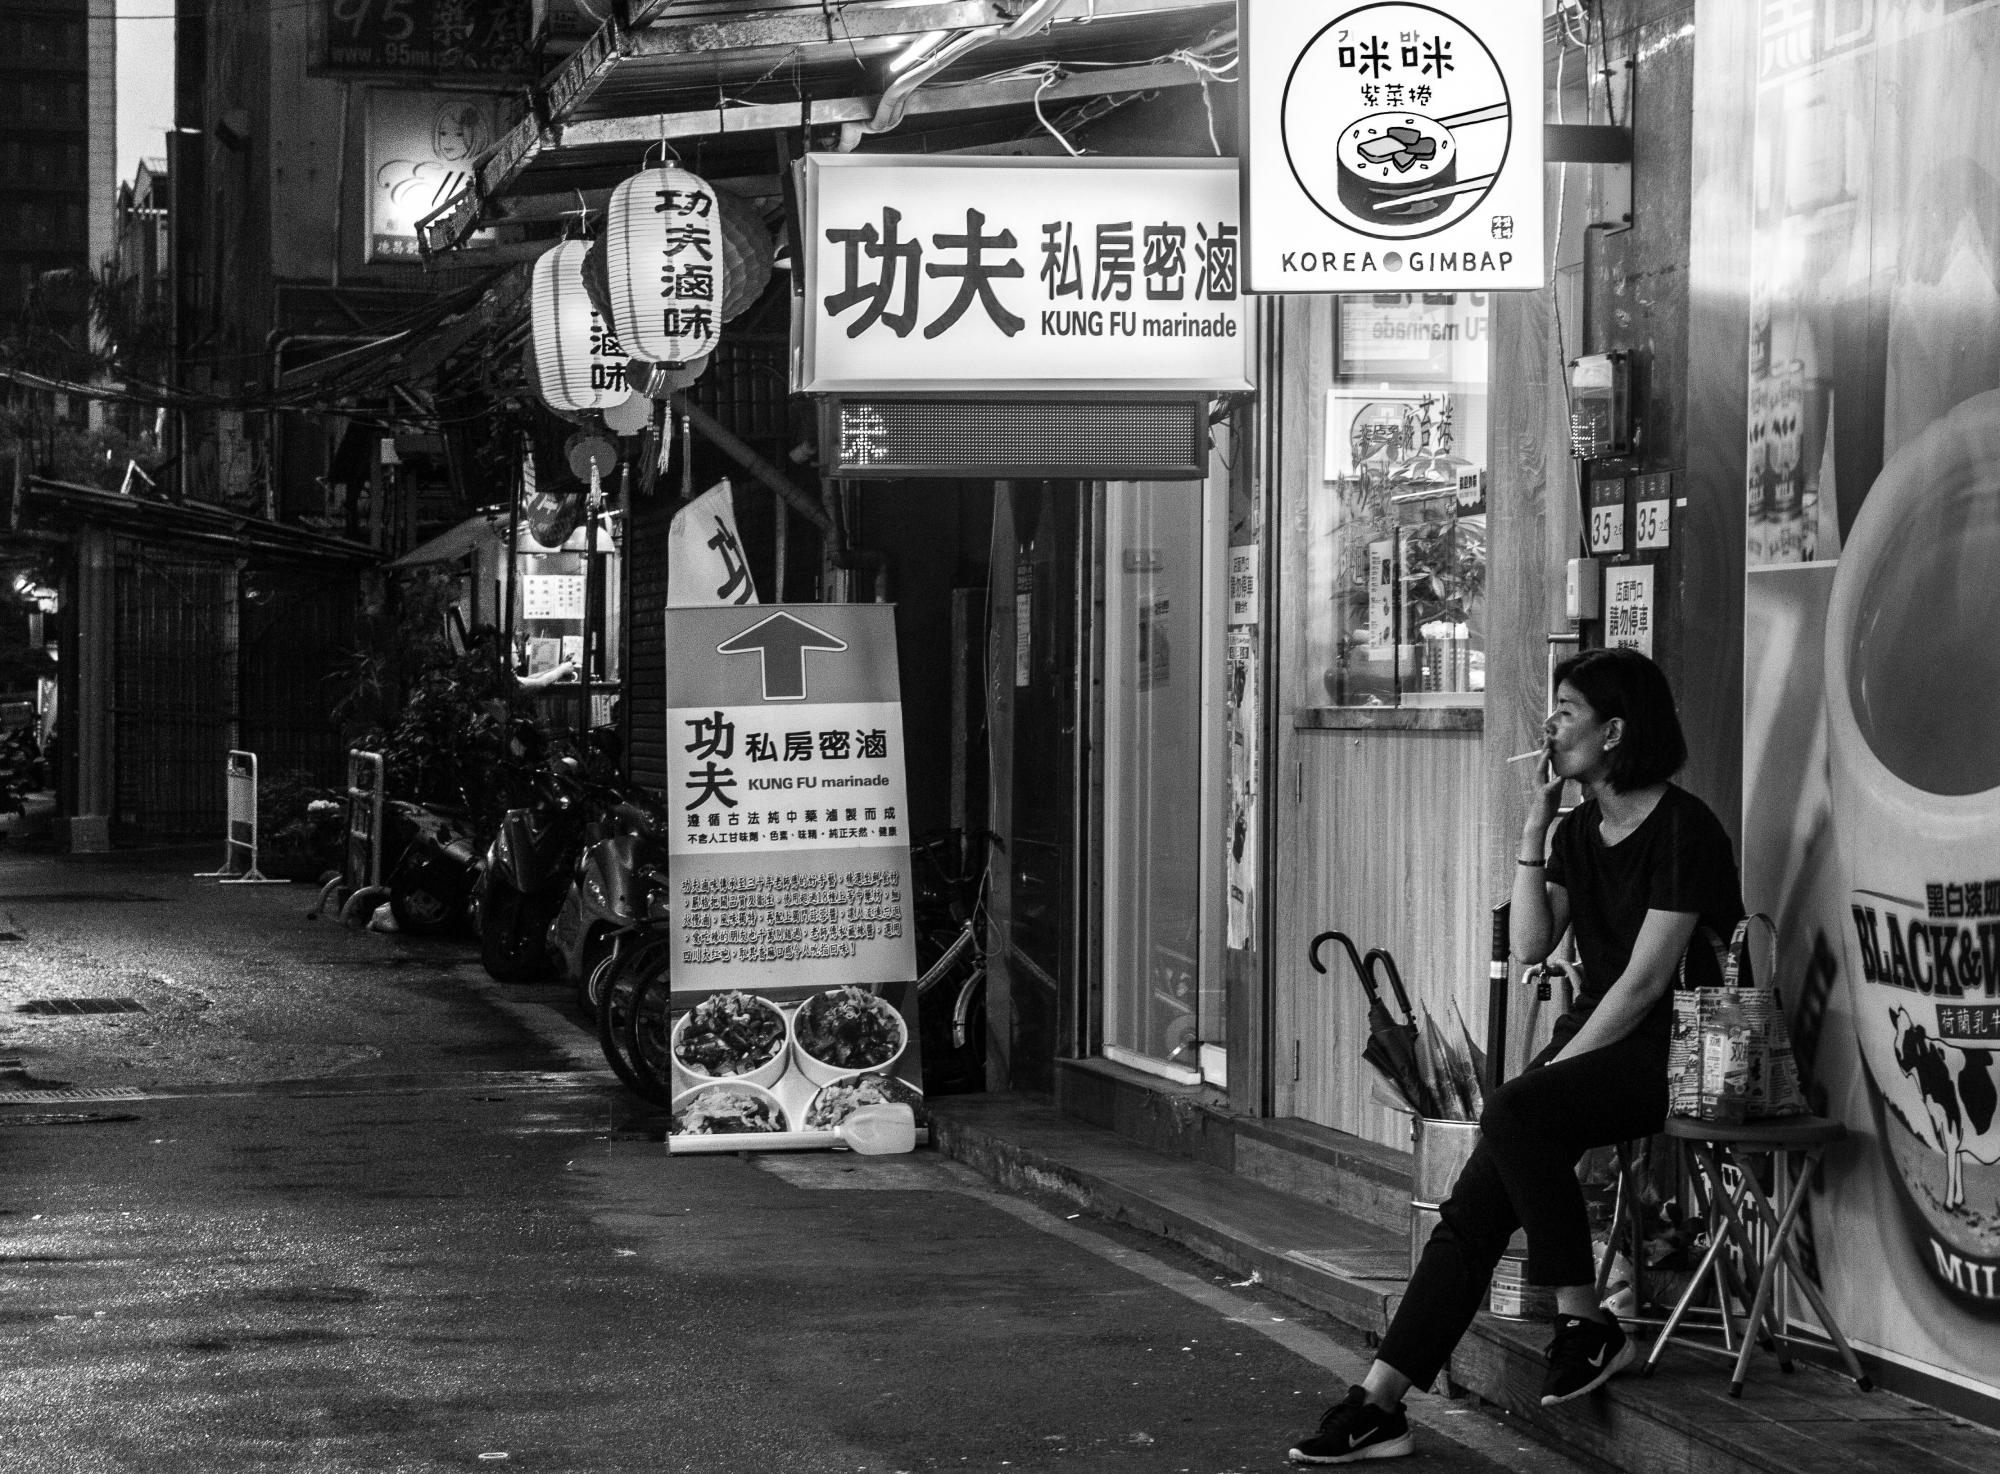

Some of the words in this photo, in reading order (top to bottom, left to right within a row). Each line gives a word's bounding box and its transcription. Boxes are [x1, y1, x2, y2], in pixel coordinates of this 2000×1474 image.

[1361, 83, 1432, 107] 紫菜捲
[655, 190, 713, 340] 功夫滷味
[823, 206, 1026, 340] 功夫
[1040, 220, 1238, 301] 私房密滷
[1282, 251, 1377, 272] KOREA
[1409, 251, 1513, 272] GIMBAP
[1041, 311, 1103, 336] KUNG
[1110, 311, 1137, 336] FU
[1143, 312, 1237, 338] marinade
[1592, 511, 1613, 547] 35
[1637, 506, 1658, 542] 35
[1615, 580, 1643, 602] 店面門口
[1609, 604, 1648, 636] 請勿停車
[684, 710, 739, 811] 功夫
[745, 728, 888, 763] 私房密滷
[748, 776, 793, 791] KUNG
[796, 776, 818, 789] FU
[821, 773, 891, 788] marinade
[1941, 1008, 2000, 1036] 荷蘭乳牛
